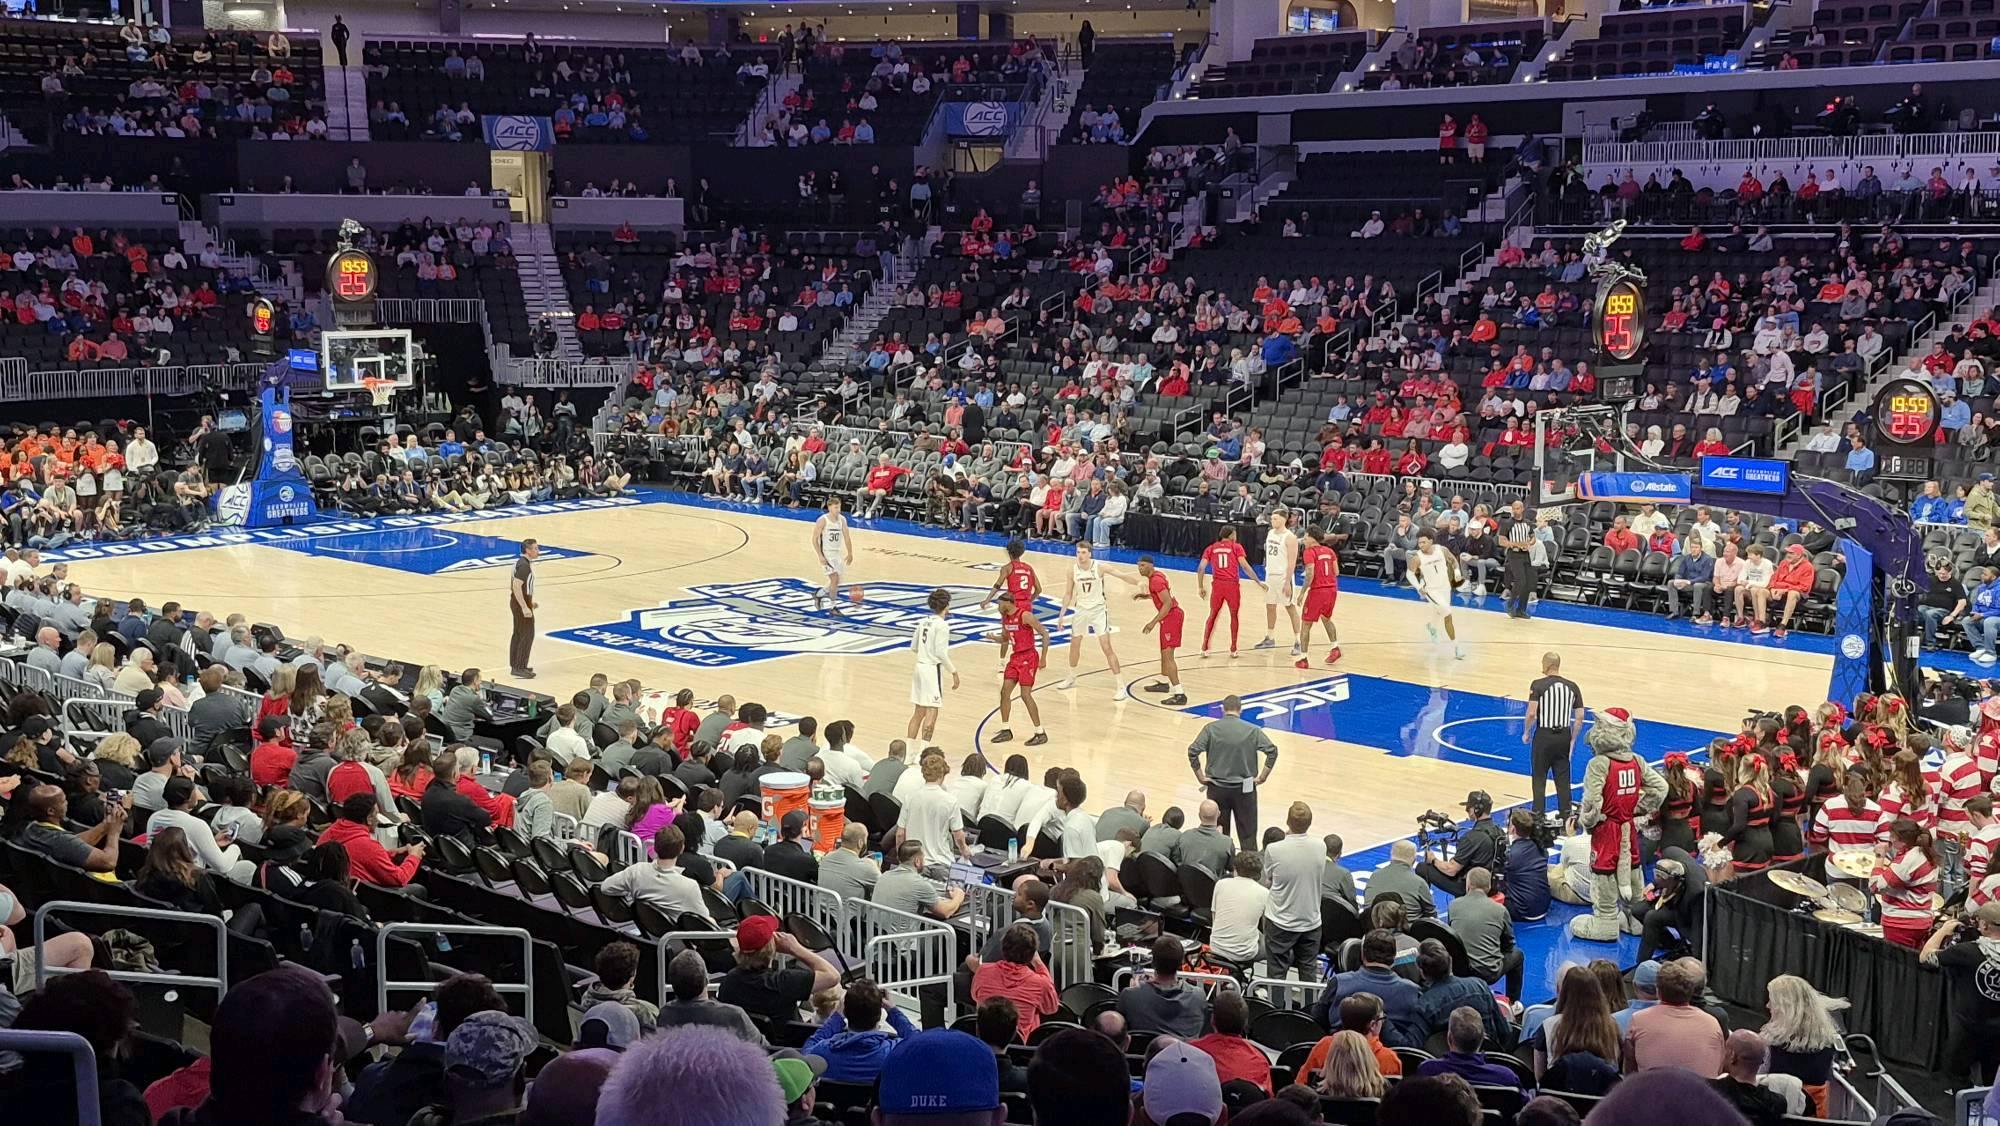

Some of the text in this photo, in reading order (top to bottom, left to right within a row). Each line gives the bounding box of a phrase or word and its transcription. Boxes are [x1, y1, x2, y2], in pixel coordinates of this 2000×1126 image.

[970, 111, 1003, 121] ACC
[500, 126, 536, 136] ACC
[1985, 200, 1998, 208] 114
[340, 273, 367, 295] 25
[1605, 315, 1632, 350] 25
[1891, 397, 1928, 414] 19:59
[1891, 413, 1921, 435] 25
[1708, 466, 1740, 479] ACC
[1645, 482, 1677, 491] Allstate
[224, 495, 249, 507] ACC
[267, 508, 308, 519] GREATNESS
[383, 497, 643, 527] GREATNESS
[829, 532, 840, 542] 30
[1268, 545, 1279, 556] 28
[1218, 553, 1229, 568] 11
[1020, 575, 1029, 590] 2
[1081, 582, 1092, 593] 17
[690, 620, 787, 638] ACC
[1238, 680, 1350, 720] ACC
[1618, 768, 1636, 788] 00
[762, 796, 774, 817] G
[810, 815, 818, 830] G
[911, 1095, 947, 1107] DUKE
